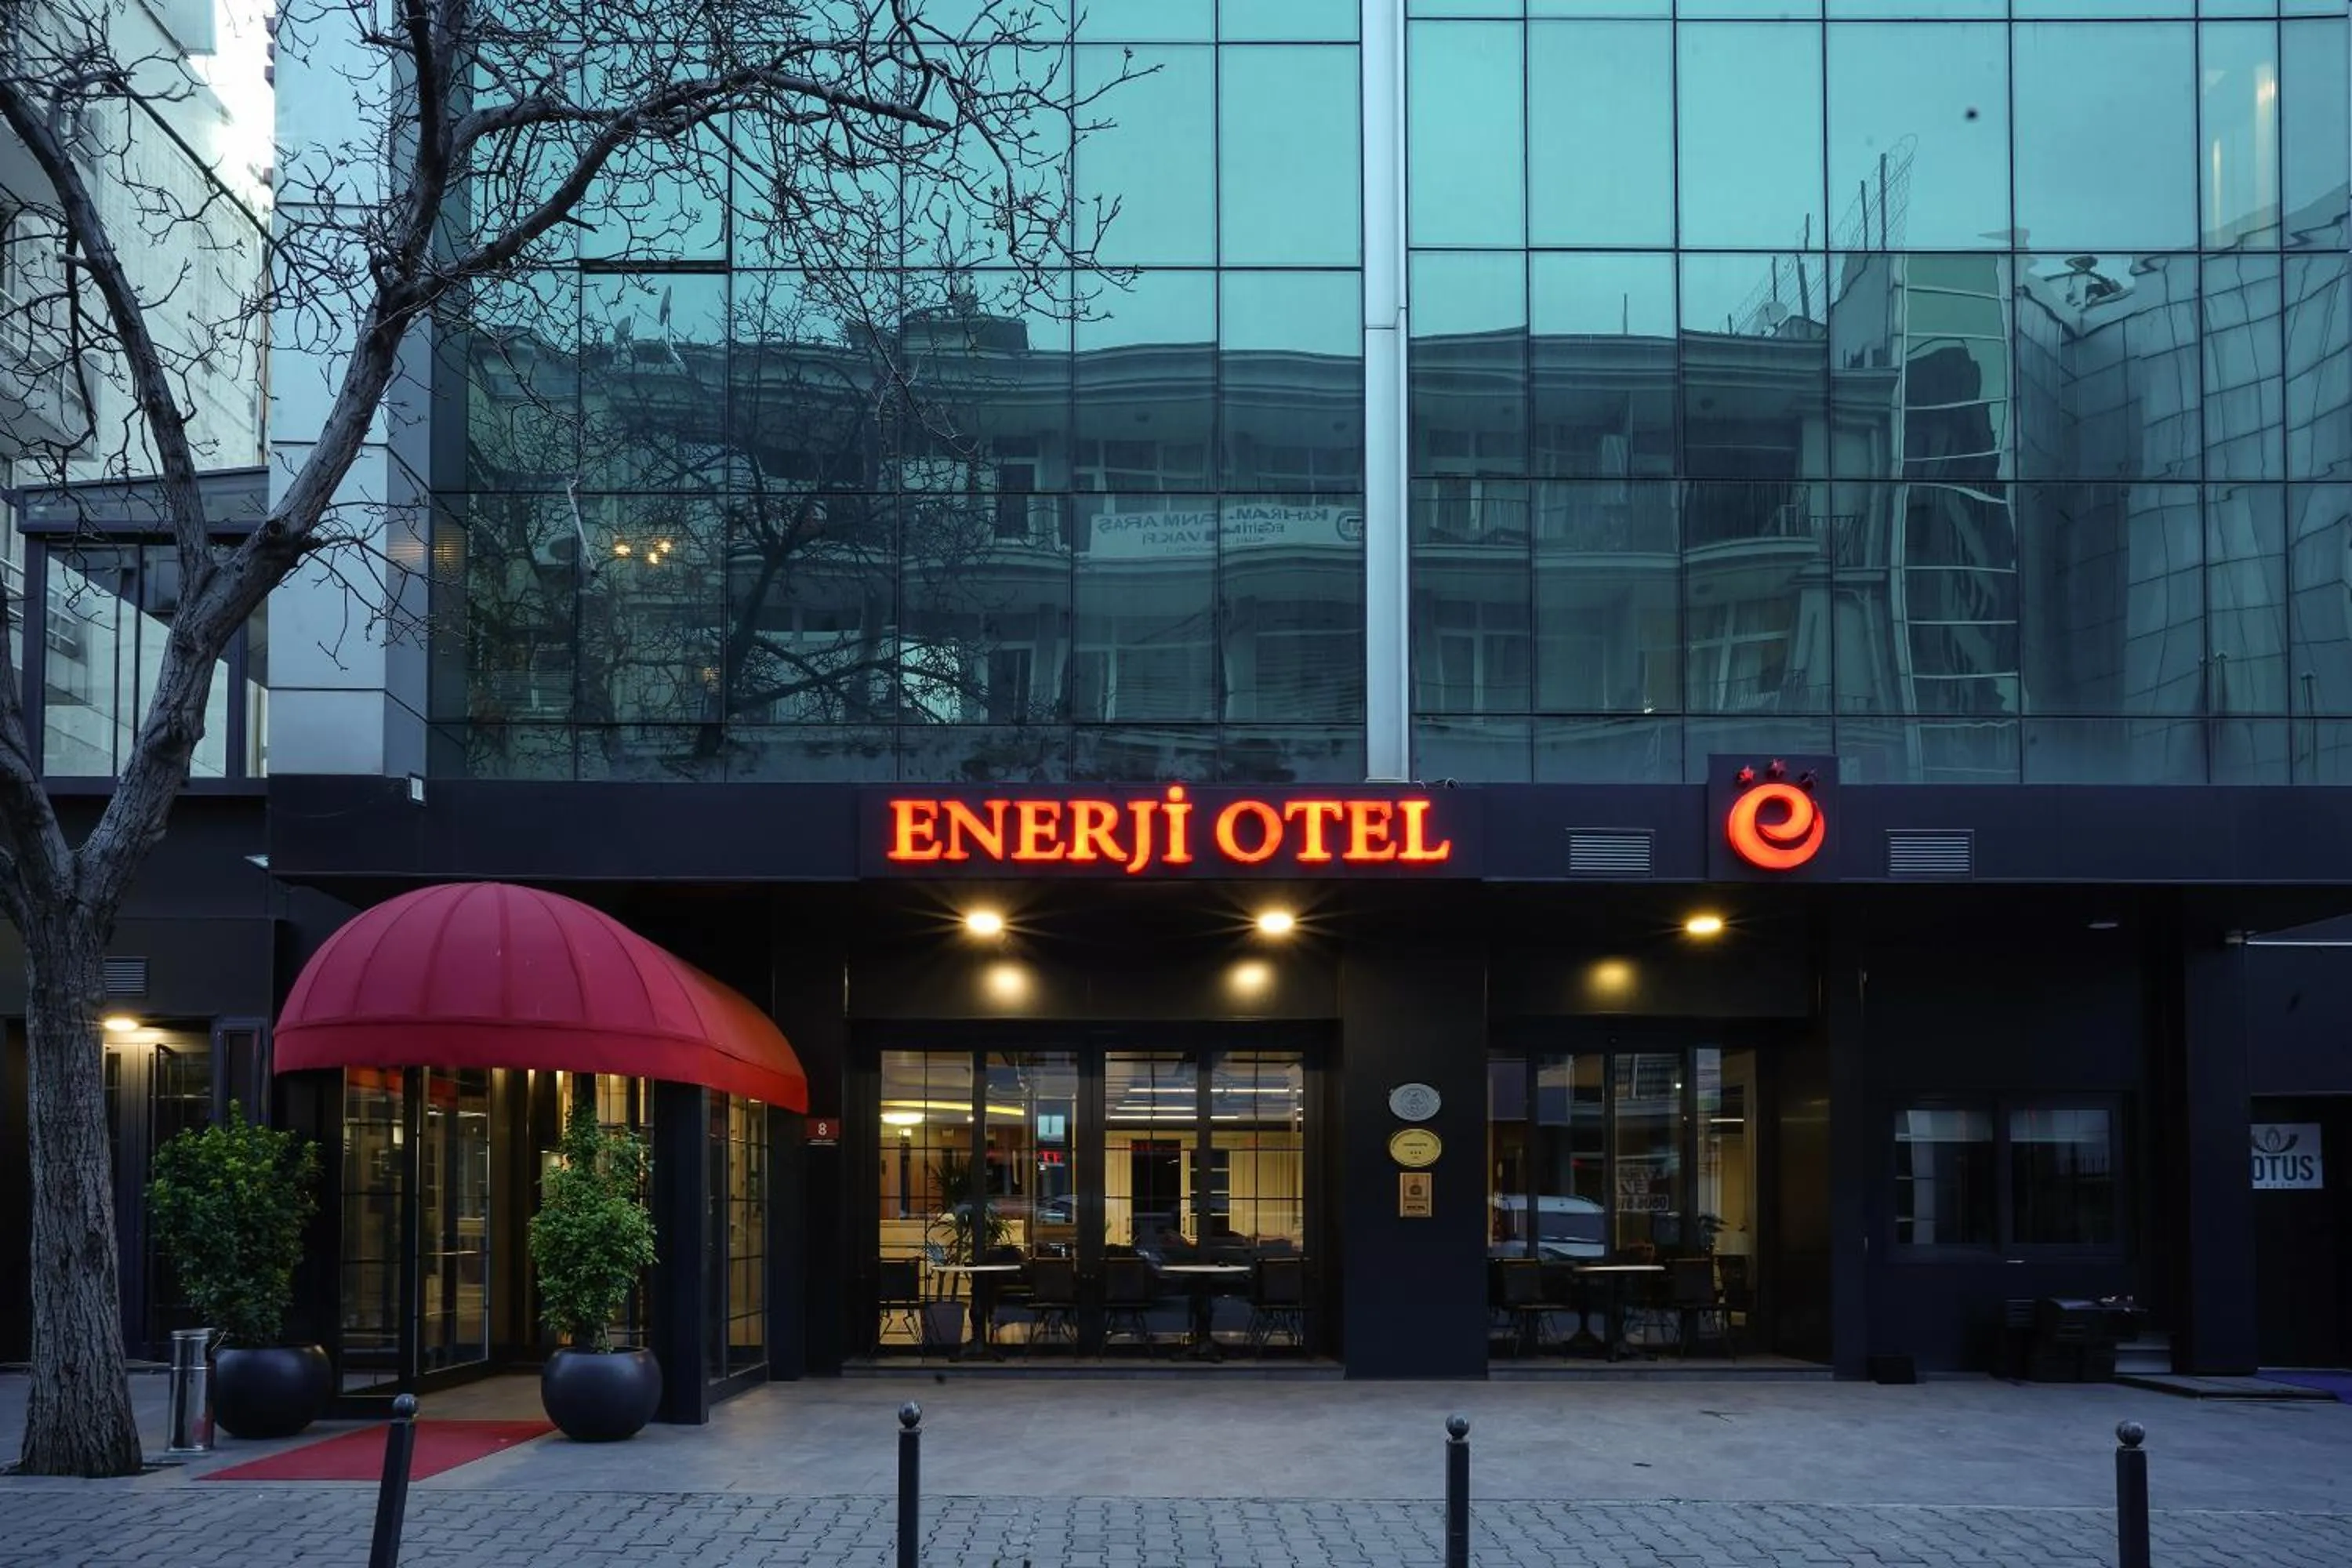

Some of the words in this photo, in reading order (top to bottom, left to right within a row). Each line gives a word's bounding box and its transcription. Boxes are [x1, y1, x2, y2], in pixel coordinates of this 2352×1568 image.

[888, 786, 1192, 873] ENERJİ
[1216, 799, 1450, 863] OTEL
[818, 1122, 827, 1136] 8
[2252, 1155, 2314, 1181] OTUS
